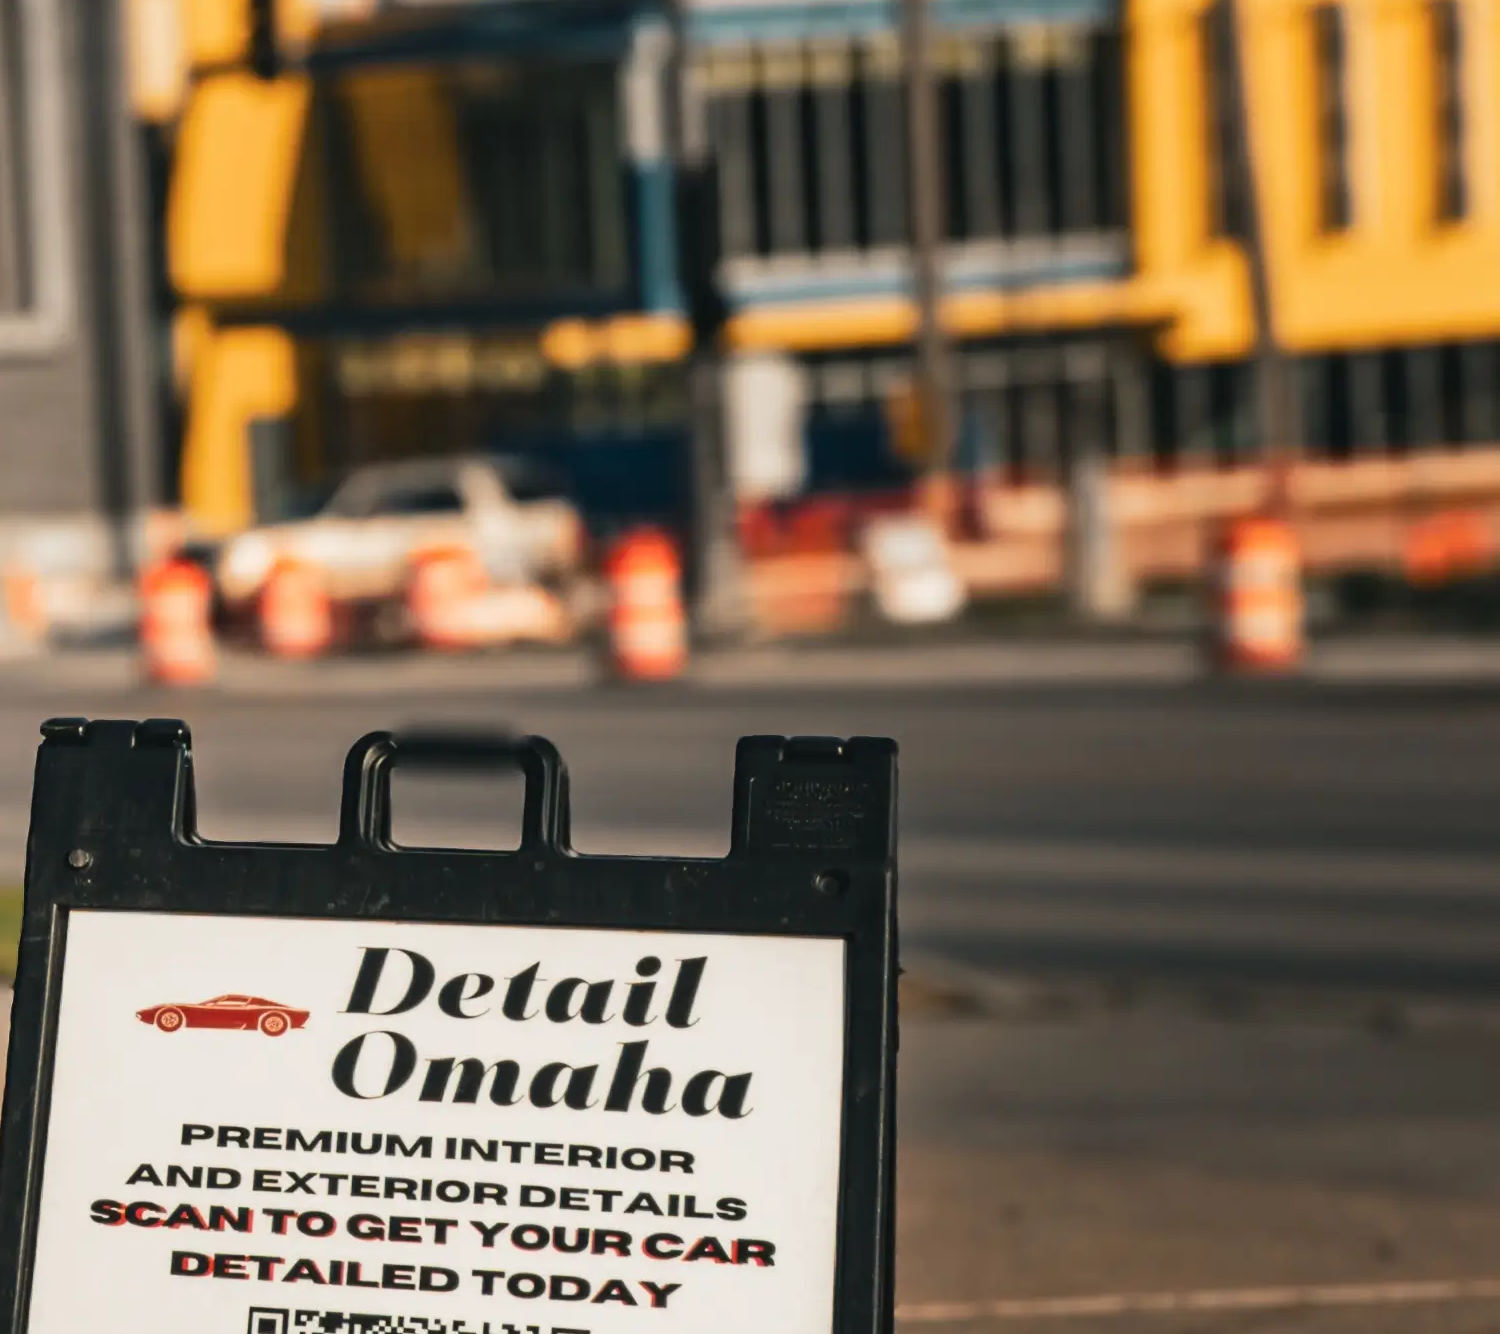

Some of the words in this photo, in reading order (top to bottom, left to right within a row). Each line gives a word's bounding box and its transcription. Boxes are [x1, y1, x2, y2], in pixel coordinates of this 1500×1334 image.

[337, 947, 707, 1028] Detail
[331, 1031, 753, 1119] Omaha
[181, 1123, 432, 1158] PREMIUM
[445, 1137, 695, 1174] INTERIOR
[125, 1163, 241, 1189] AND
[253, 1170, 507, 1206] EXTERIOR
[520, 1185, 747, 1221] DETAILS
[90, 1199, 253, 1232] SCAN
[262, 1208, 336, 1237] TO
[347, 1214, 458, 1244] GET
[470, 1221, 632, 1257] YOUR
[642, 1233, 776, 1267] CAR
[170, 1251, 459, 1292] DETAILED
[472, 1270, 682, 1309] TODAY
